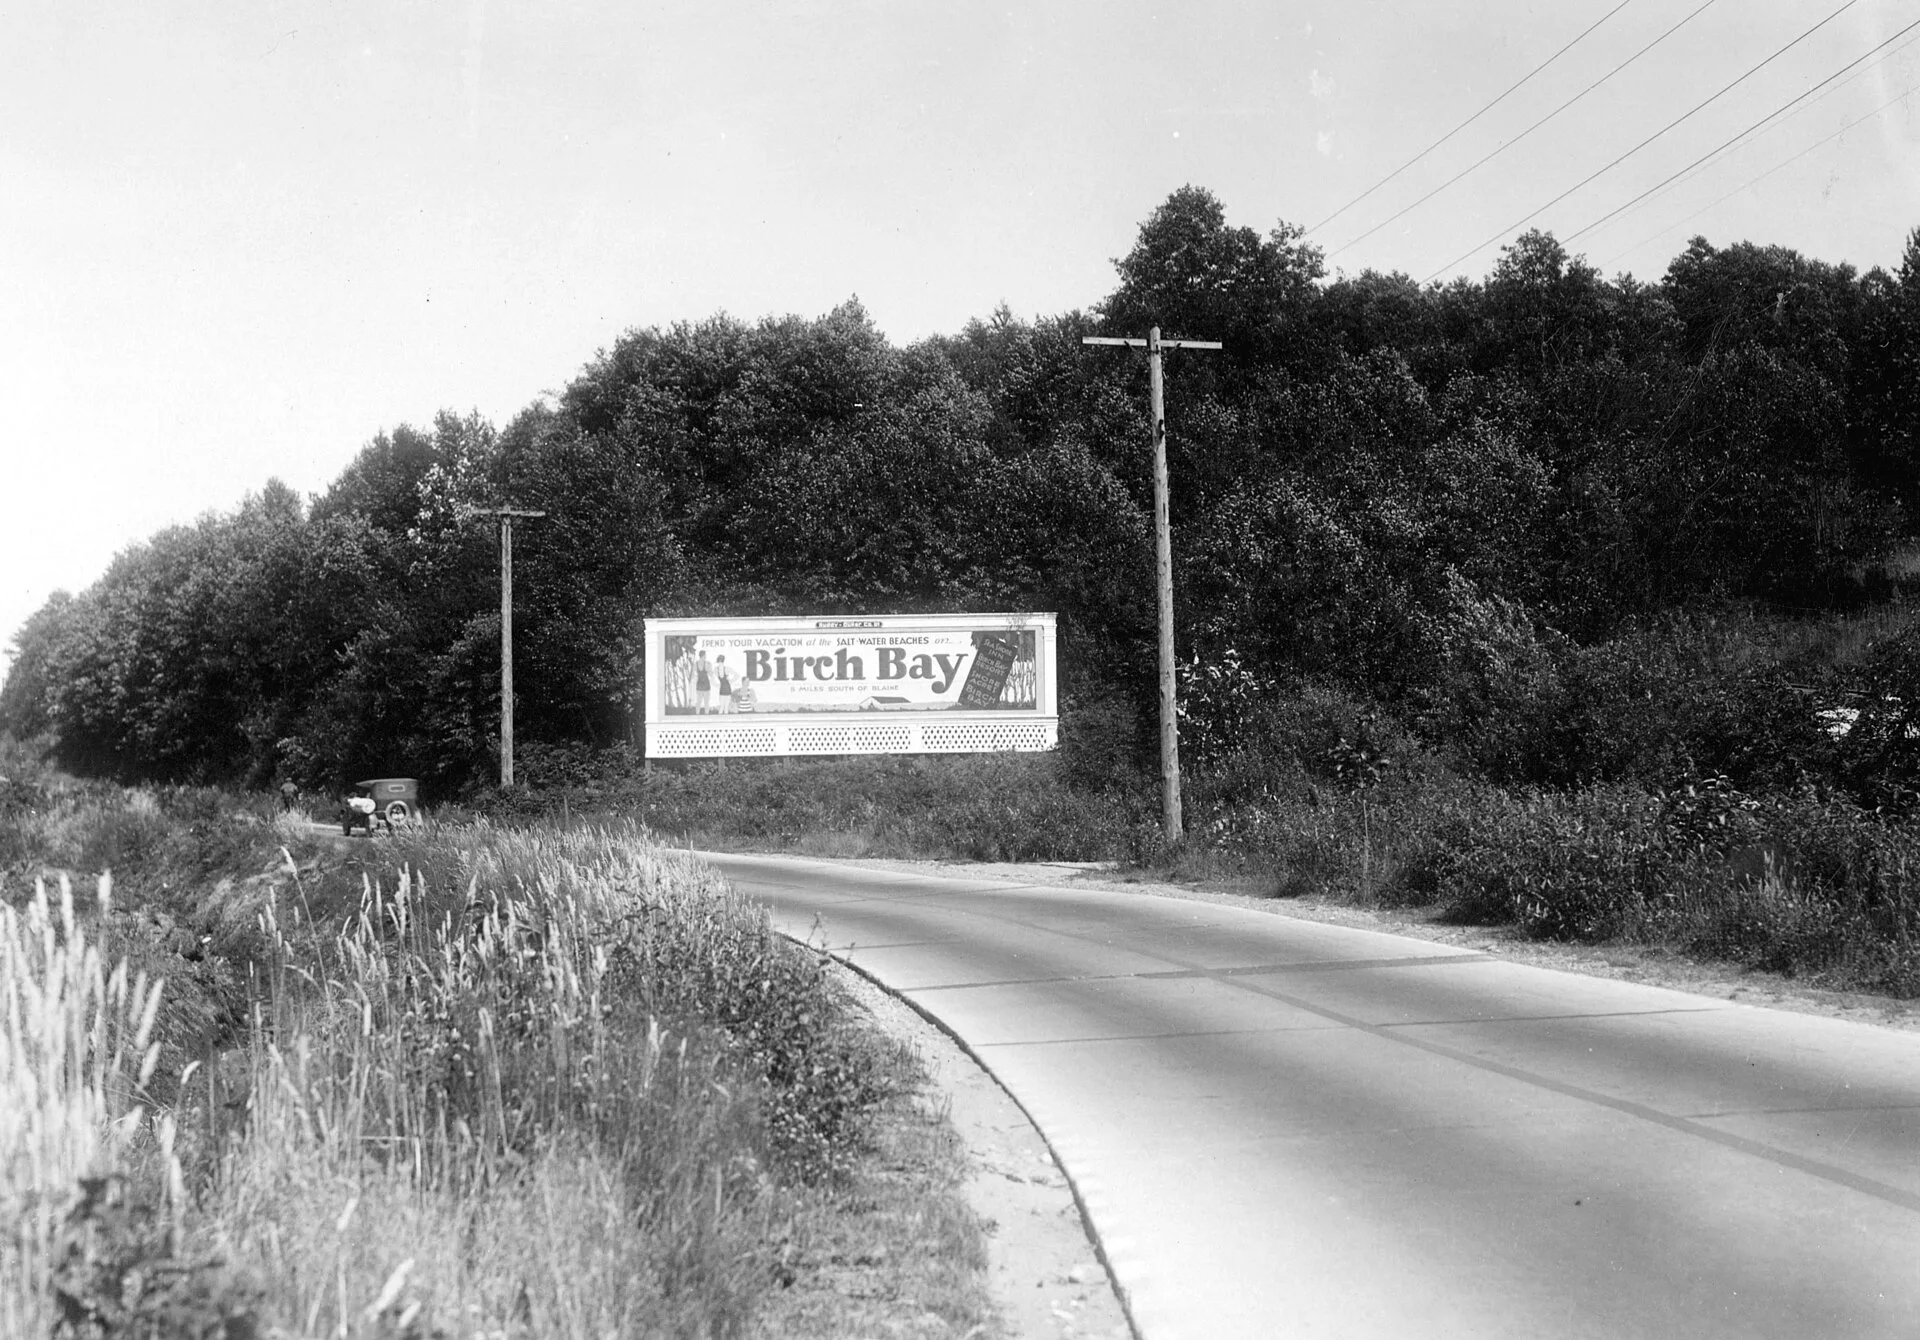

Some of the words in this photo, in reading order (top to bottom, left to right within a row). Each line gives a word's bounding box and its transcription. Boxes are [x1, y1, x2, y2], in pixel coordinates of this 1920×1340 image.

[702, 639, 726, 648] SPEND
[729, 639, 753, 647] YOUR
[755, 638, 803, 647] VACATION
[806, 638, 817, 646] at
[819, 638, 832, 646] the
[889, 636, 929, 646] BEACHES
[988, 649, 1004, 659] INN
[743, 646, 866, 681] Birch
[875, 647, 969, 694] Bay
[976, 660, 1006, 676] RESORT
[969, 678, 997, 693] ACRES
[971, 670, 1000, 687] SHORE
[798, 684, 824, 692] MILES
[828, 684, 854, 692] SOUTH
[871, 684, 899, 692] BLAINE
[966, 684, 996, 704] BIRCH
[967, 694, 989, 707] BAY
